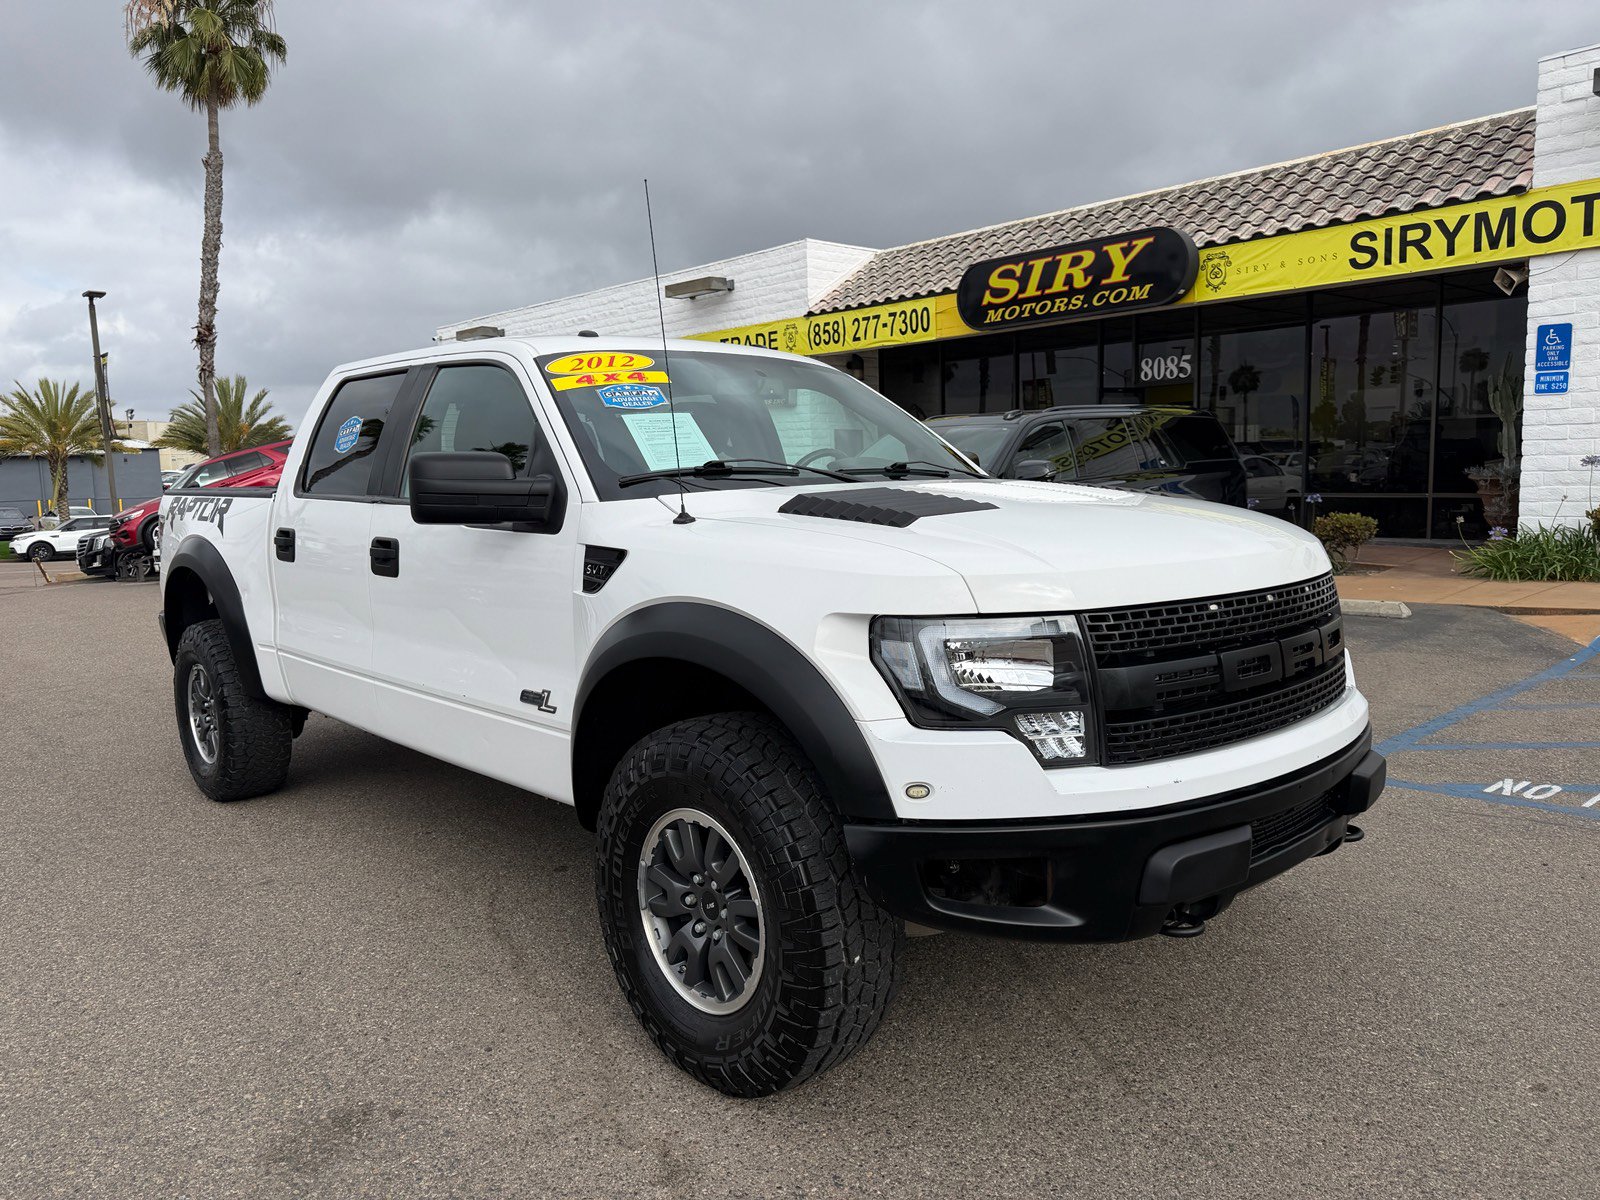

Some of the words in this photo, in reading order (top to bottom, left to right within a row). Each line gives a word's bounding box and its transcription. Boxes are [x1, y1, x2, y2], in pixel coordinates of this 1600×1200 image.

[1236, 262, 1270, 275] SIRY
[1279, 259, 1287, 269] &
[1297, 251, 1339, 266] SONS
[1348, 193, 1600, 270] SIRYMOT
[981, 236, 1155, 306] SIRY
[983, 283, 1154, 324] MOTORS.COM
[807, 315, 847, 350] (858)
[851, 306, 931, 343] 277-7300
[569, 355, 635, 372] 2012
[1140, 354, 1192, 381] 8085
[1551, 382, 1567, 390] $250
[166, 496, 234, 539] RAPTOR
[586, 564, 606, 576] SVT
[1097, 614, 1345, 711] FORD
[1483, 778, 1562, 800] NO
